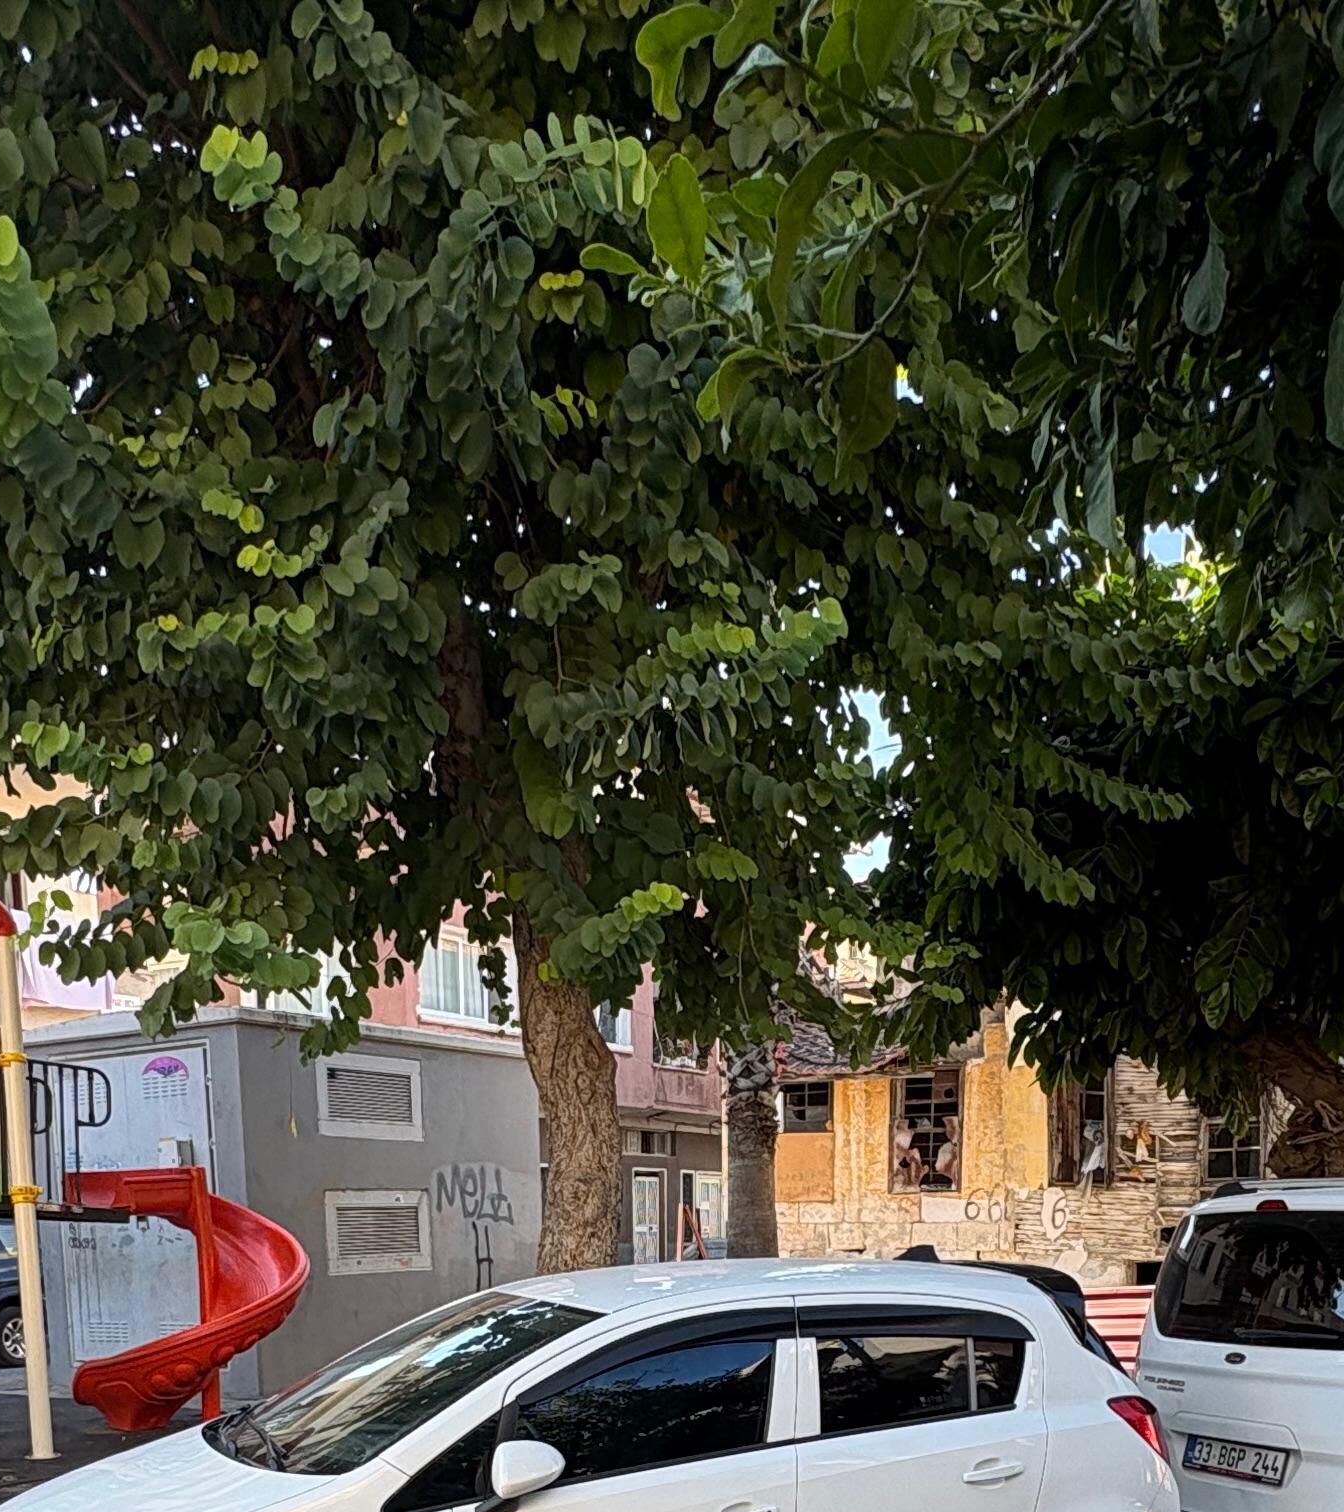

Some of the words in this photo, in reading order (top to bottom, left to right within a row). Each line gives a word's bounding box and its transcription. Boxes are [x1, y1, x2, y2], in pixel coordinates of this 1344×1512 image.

[1193, 1441, 1213, 1463] 33
[1217, 1446, 1246, 1469] BGP
[1251, 1452, 1279, 1477] 244
